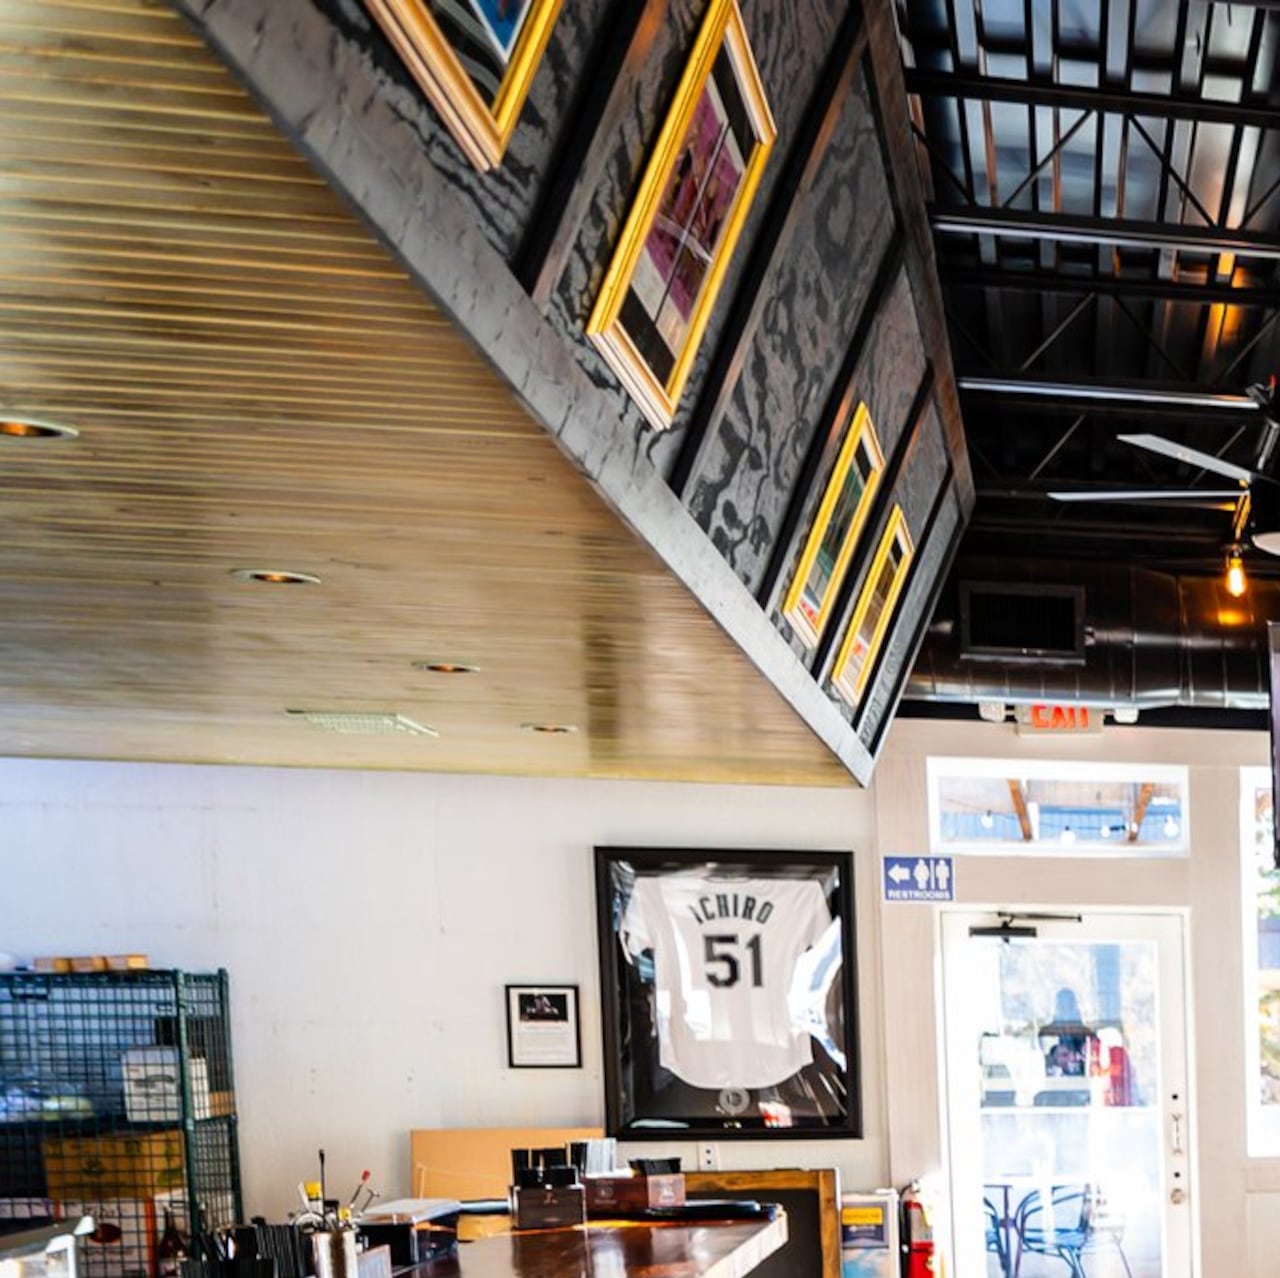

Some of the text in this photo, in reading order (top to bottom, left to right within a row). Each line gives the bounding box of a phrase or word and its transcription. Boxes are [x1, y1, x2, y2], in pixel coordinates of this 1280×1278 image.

[688, 893, 775, 924] ICHIRO
[887, 889, 951, 900] RESTROOMS
[703, 933, 763, 988] 51
